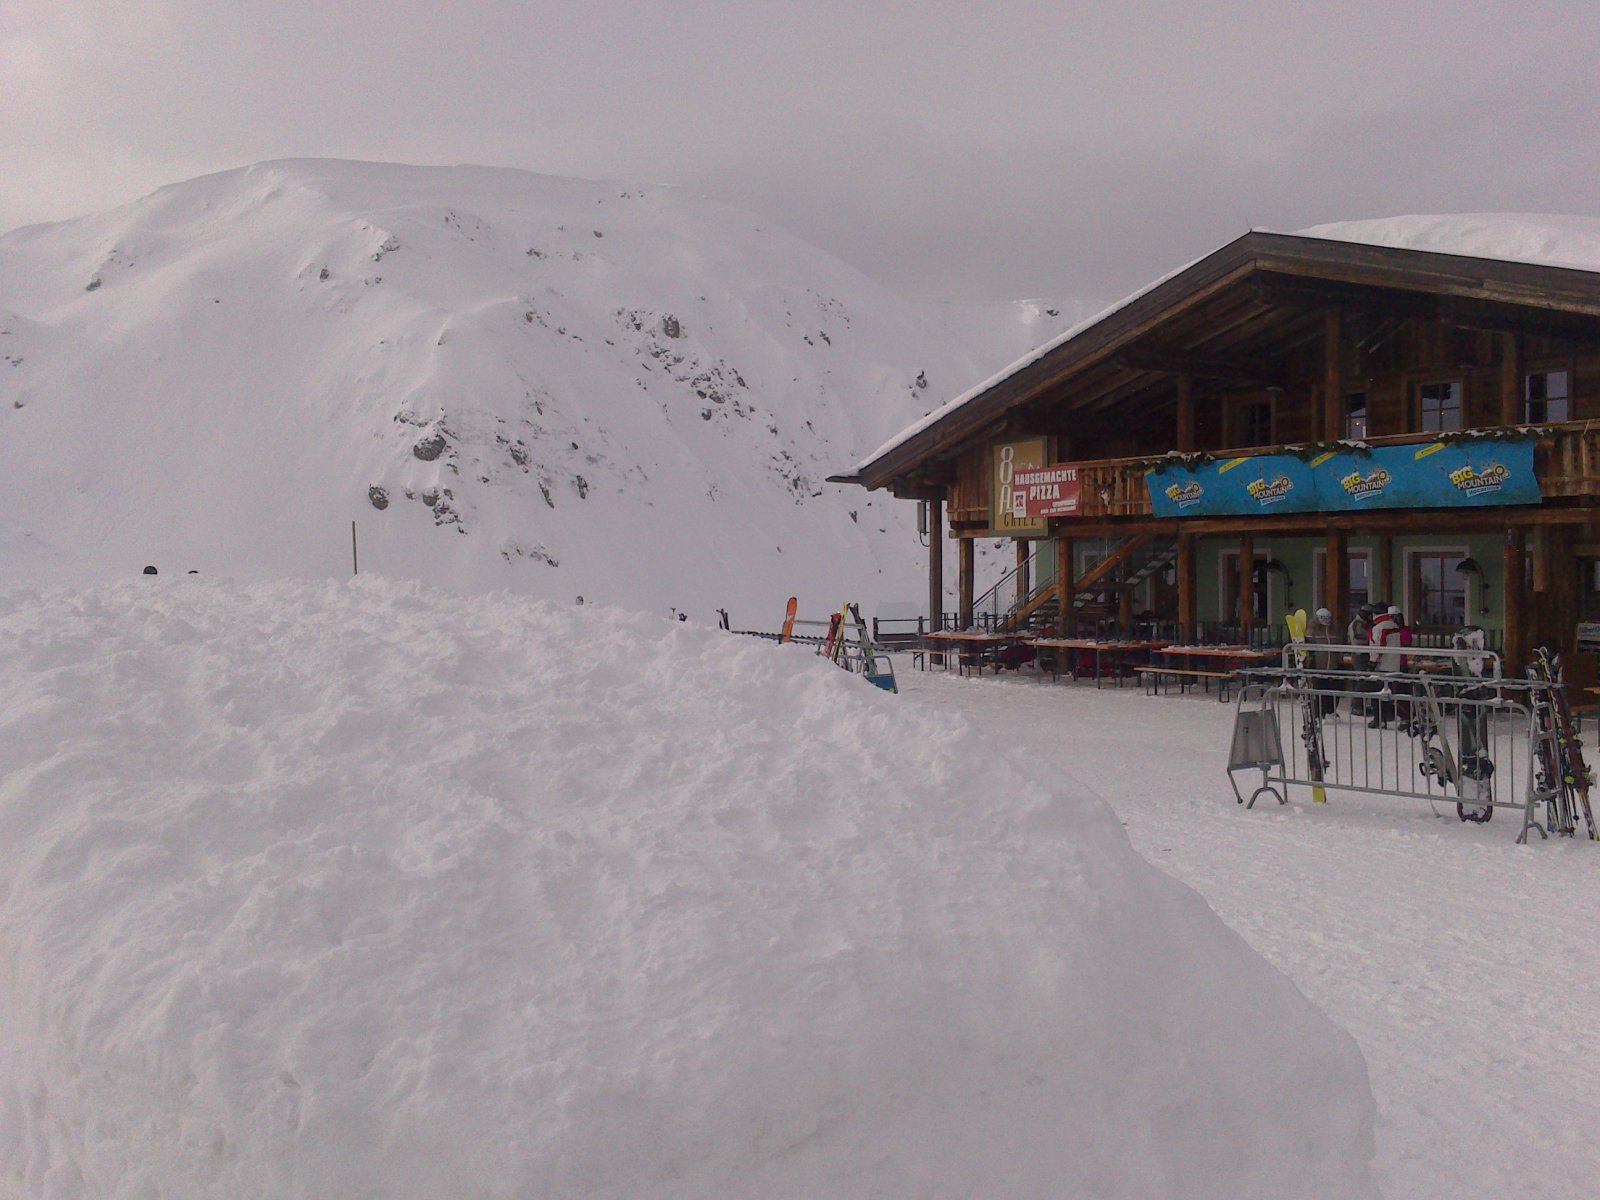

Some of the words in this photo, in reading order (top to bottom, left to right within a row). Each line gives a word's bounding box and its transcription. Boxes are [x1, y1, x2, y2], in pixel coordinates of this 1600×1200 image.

[1014, 470, 1077, 485] HAUSGEMACHTE
[1343, 476, 1361, 488] BIG
[1452, 470, 1473, 484] BIG
[1457, 476, 1503, 489] MOUNTAIN
[1029, 485, 1061, 500] PIZZA
[1167, 487, 1181, 498] BIG
[1249, 482, 1265, 494] BIG
[1253, 487, 1287, 499] MOUNTAIN
[1347, 482, 1384, 494] MOUNTAIN
[1172, 491, 1200, 502] MOUNTAIN
